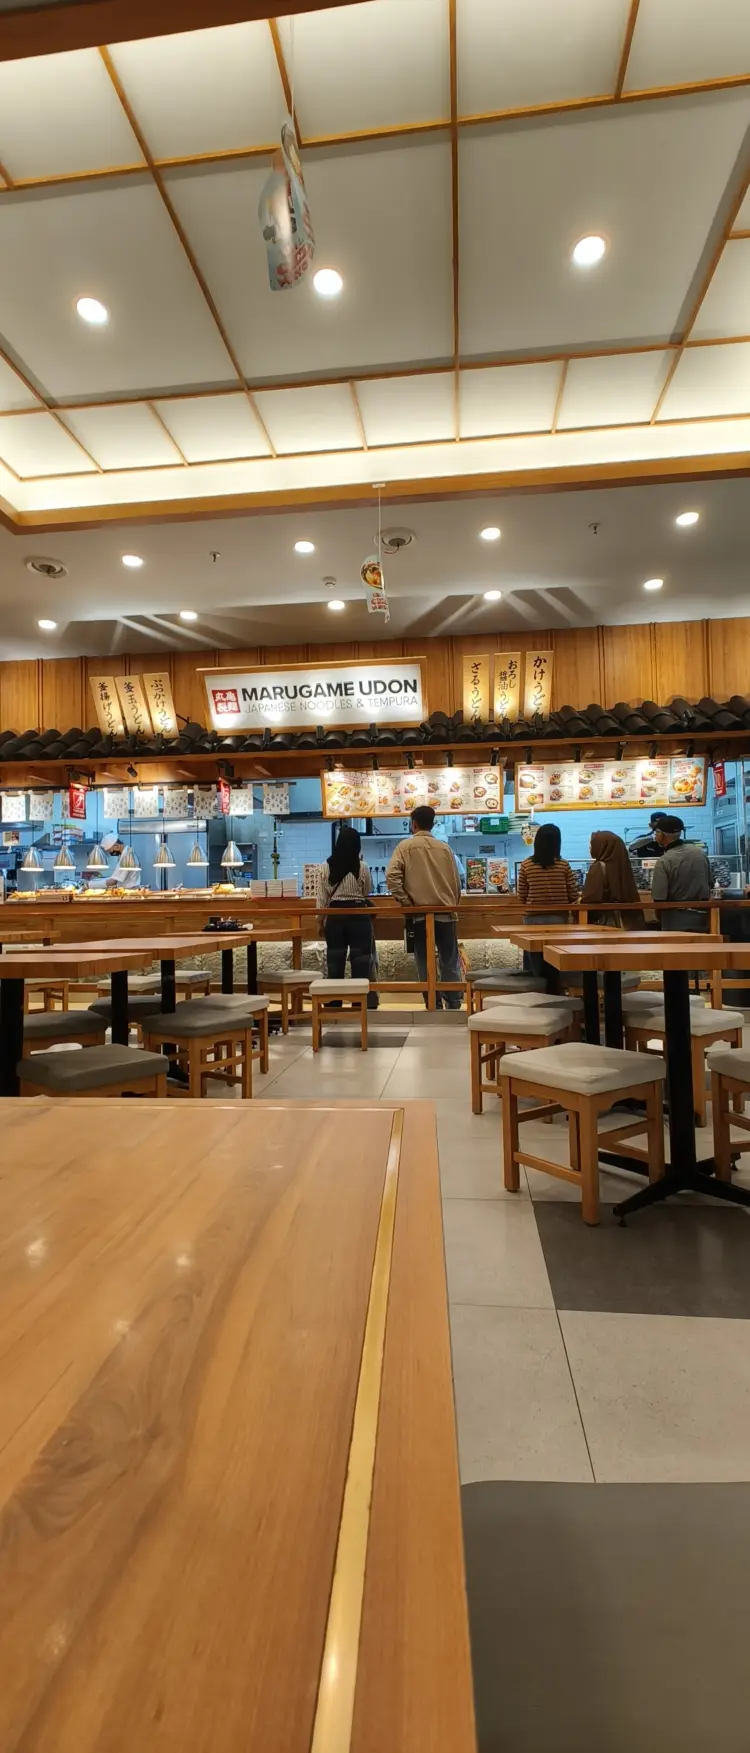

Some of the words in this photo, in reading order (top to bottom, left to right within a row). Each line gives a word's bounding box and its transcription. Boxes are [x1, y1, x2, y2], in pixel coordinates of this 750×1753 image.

[241, 681, 354, 701] MARUGAME
[359, 679, 417, 696] UDON
[508, 660, 518, 689] おろし
[532, 656, 547, 719] かけうどん
[98, 682, 117, 737] 釜揚げうどん
[124, 682, 145, 735] 釜玉うどん
[245, 701, 297, 713] JAPANESE
[300, 699, 352, 711] NOODLES
[356, 698, 364, 708] &
[368, 696, 418, 707] TEMPURA
